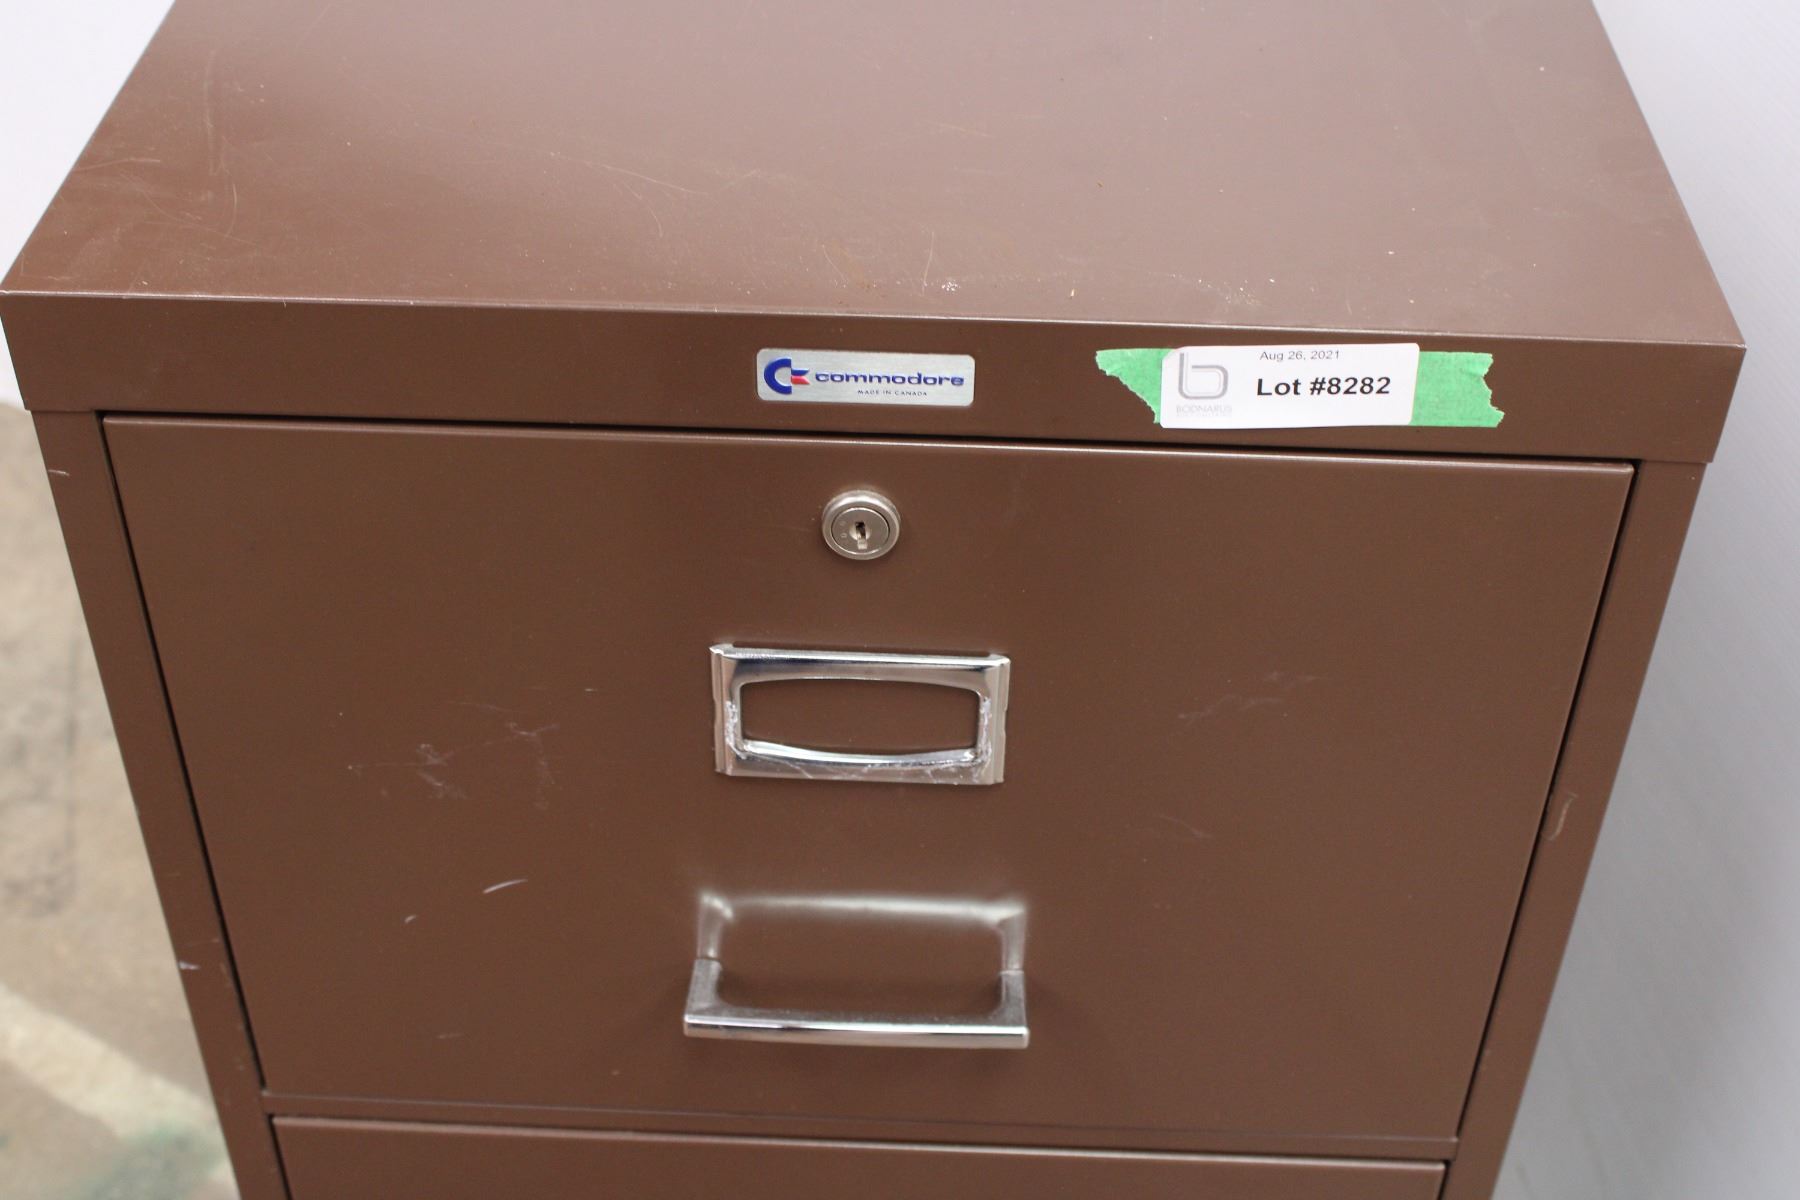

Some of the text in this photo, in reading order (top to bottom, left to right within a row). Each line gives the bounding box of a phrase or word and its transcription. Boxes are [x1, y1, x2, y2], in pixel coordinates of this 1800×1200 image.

[1259, 349, 1340, 363] Aug 26, 2021
[815, 372, 965, 386] commodore
[1257, 376, 1392, 396] Lot #8282
